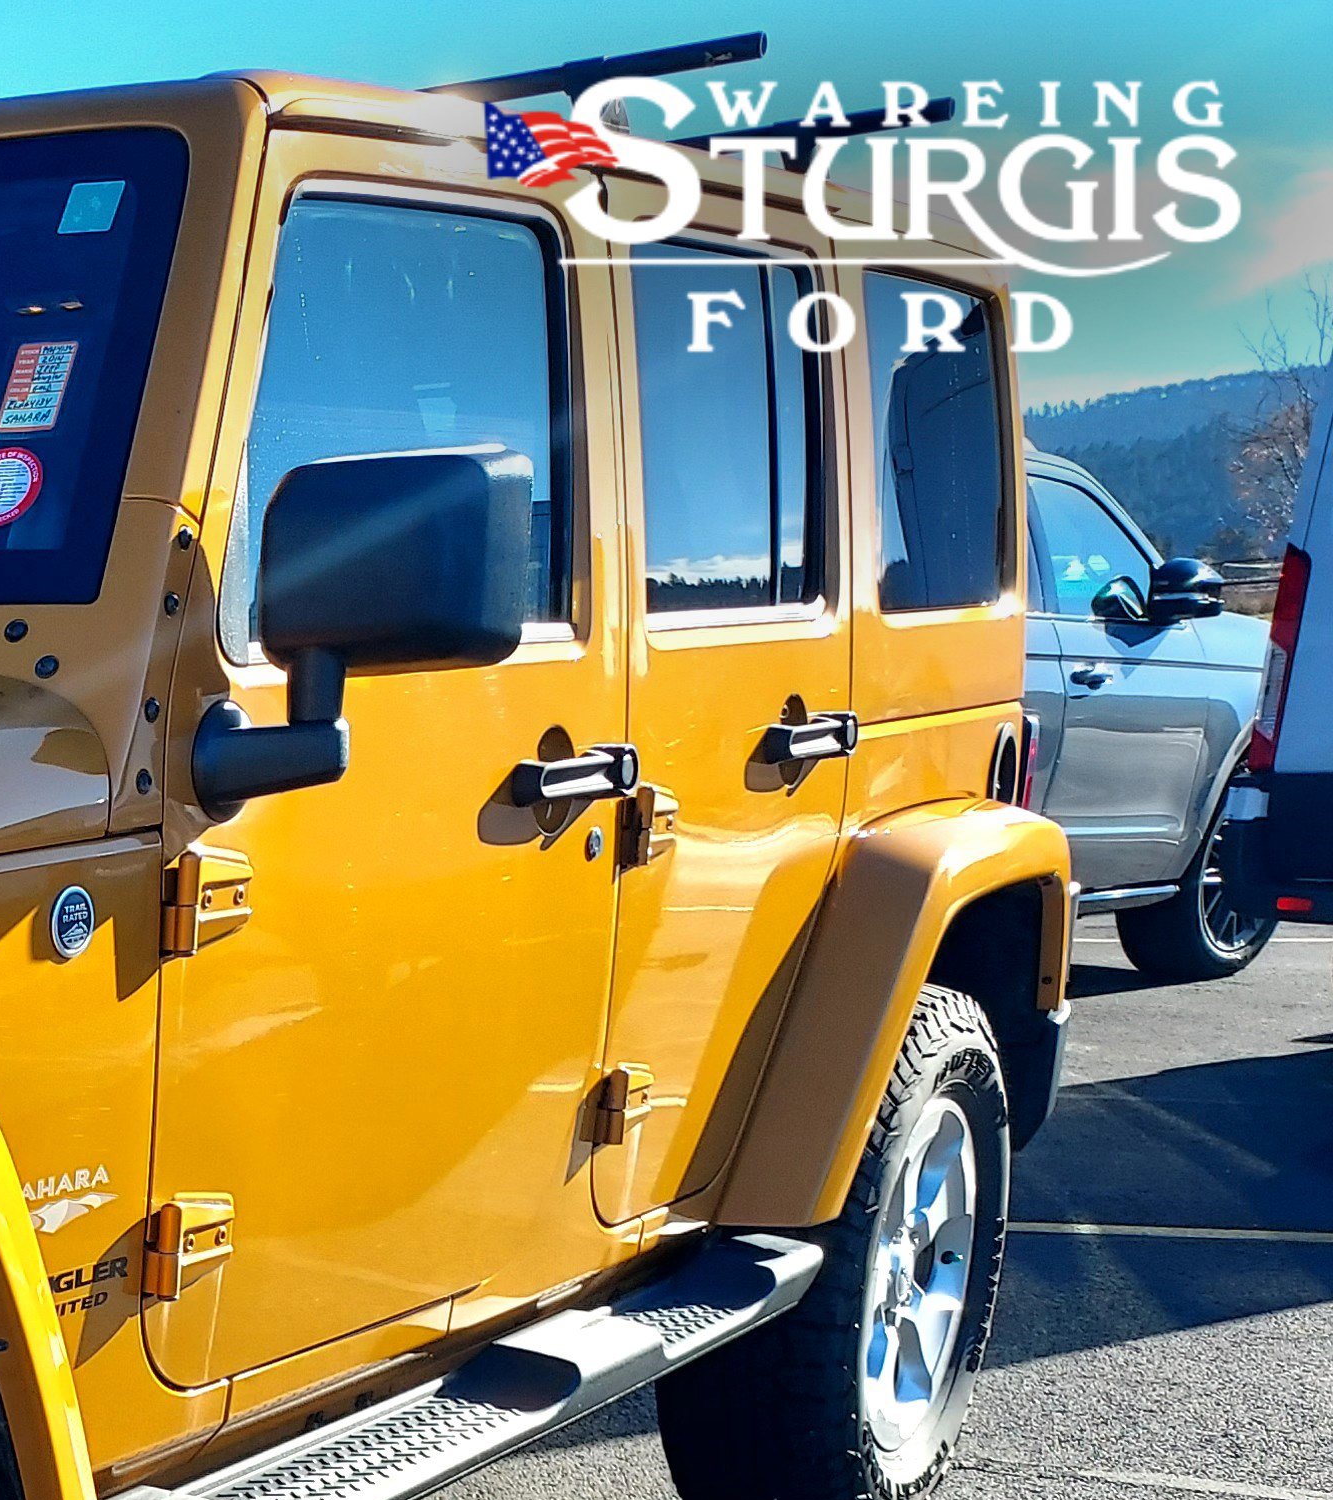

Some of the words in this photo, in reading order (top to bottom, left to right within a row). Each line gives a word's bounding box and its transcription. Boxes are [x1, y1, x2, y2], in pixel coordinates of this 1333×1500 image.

[2, 409, 52, 425] SAHARA
[64, 902, 88, 914] TRAIL
[63, 911, 89, 924] RATED
